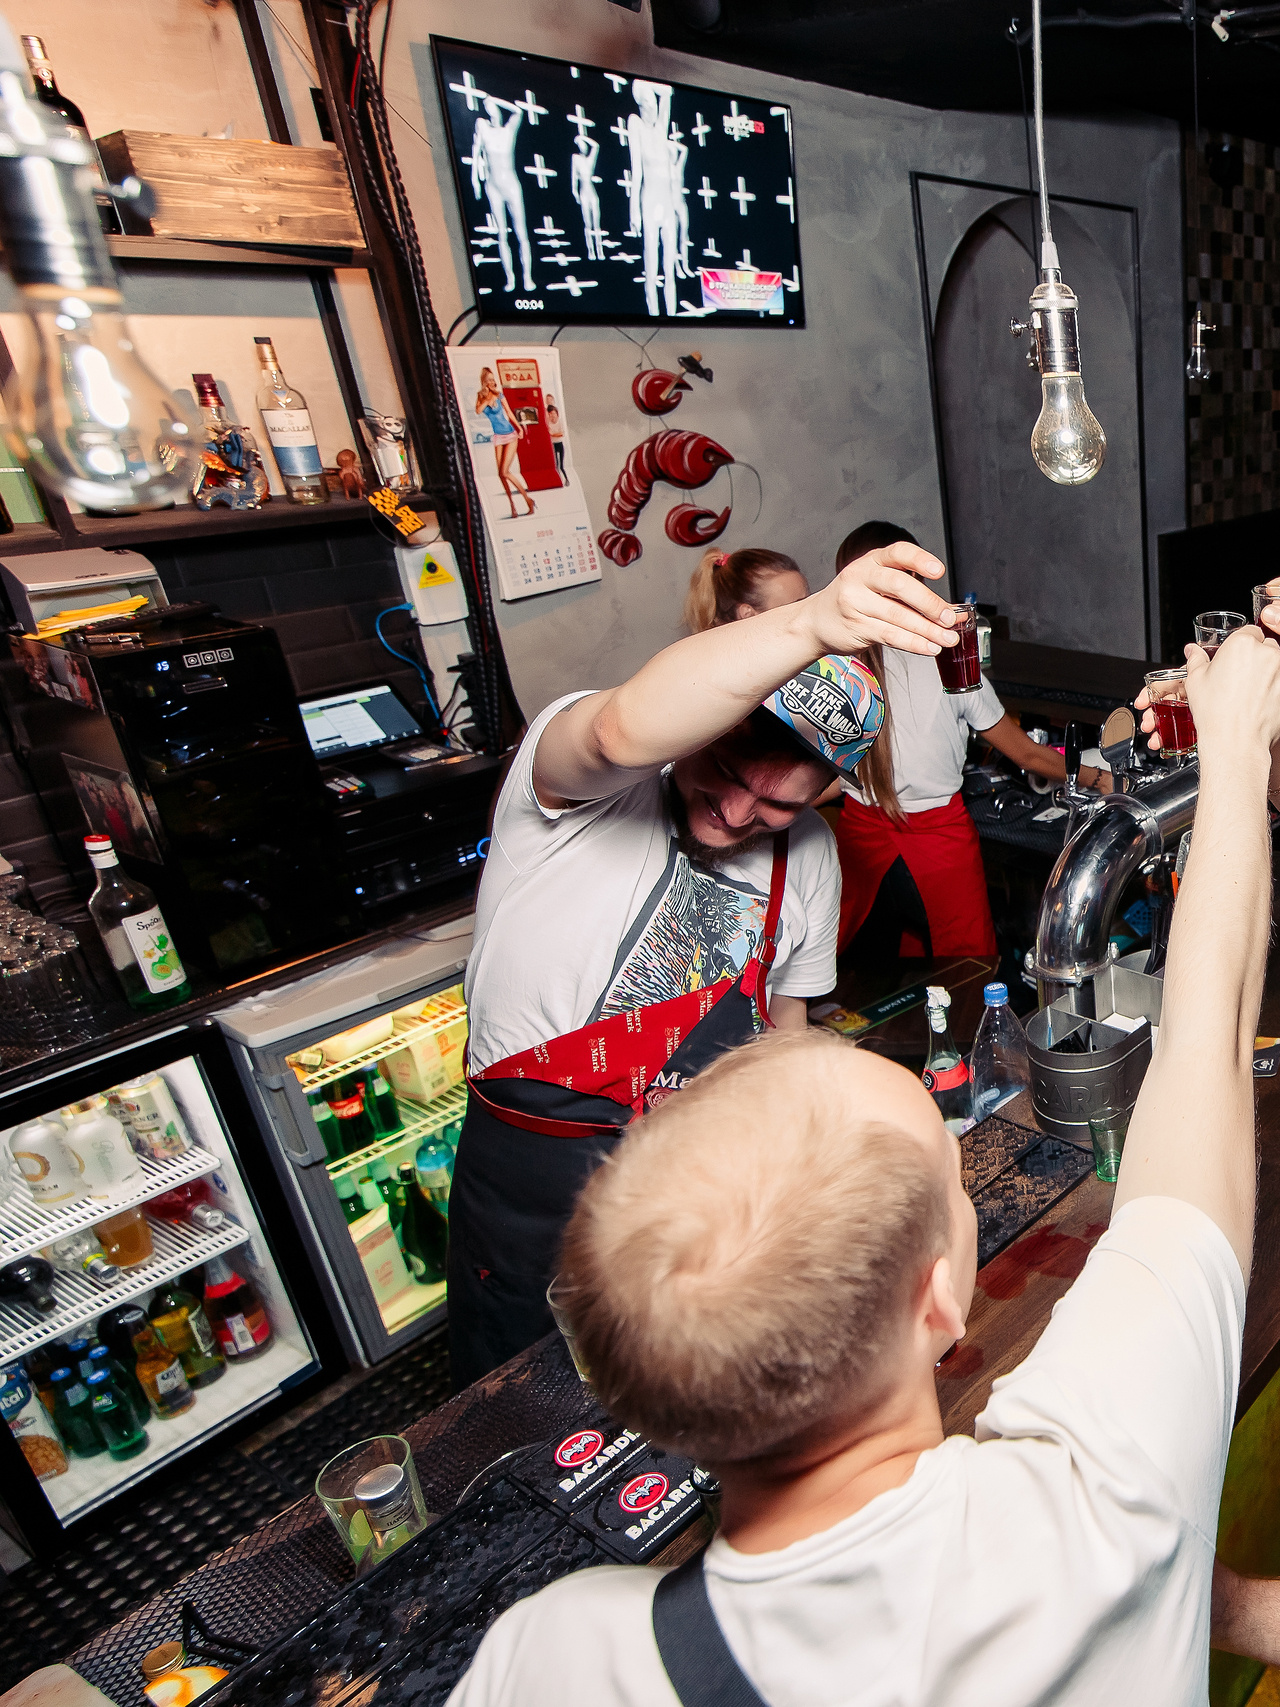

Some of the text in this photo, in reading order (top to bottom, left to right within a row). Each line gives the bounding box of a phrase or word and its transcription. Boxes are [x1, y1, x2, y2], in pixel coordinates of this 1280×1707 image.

[514, 299, 545, 310] 00:04
[505, 373, 533, 381] ВОДА
[395, 516, 425, 536] FIRST
[786, 679, 810, 699] OFF
[806, 692, 833, 721] THE
[812, 680, 846, 711] VANS
[590, 1047, 600, 1073] Mark
[598, 1037, 607, 1073] Maker's
